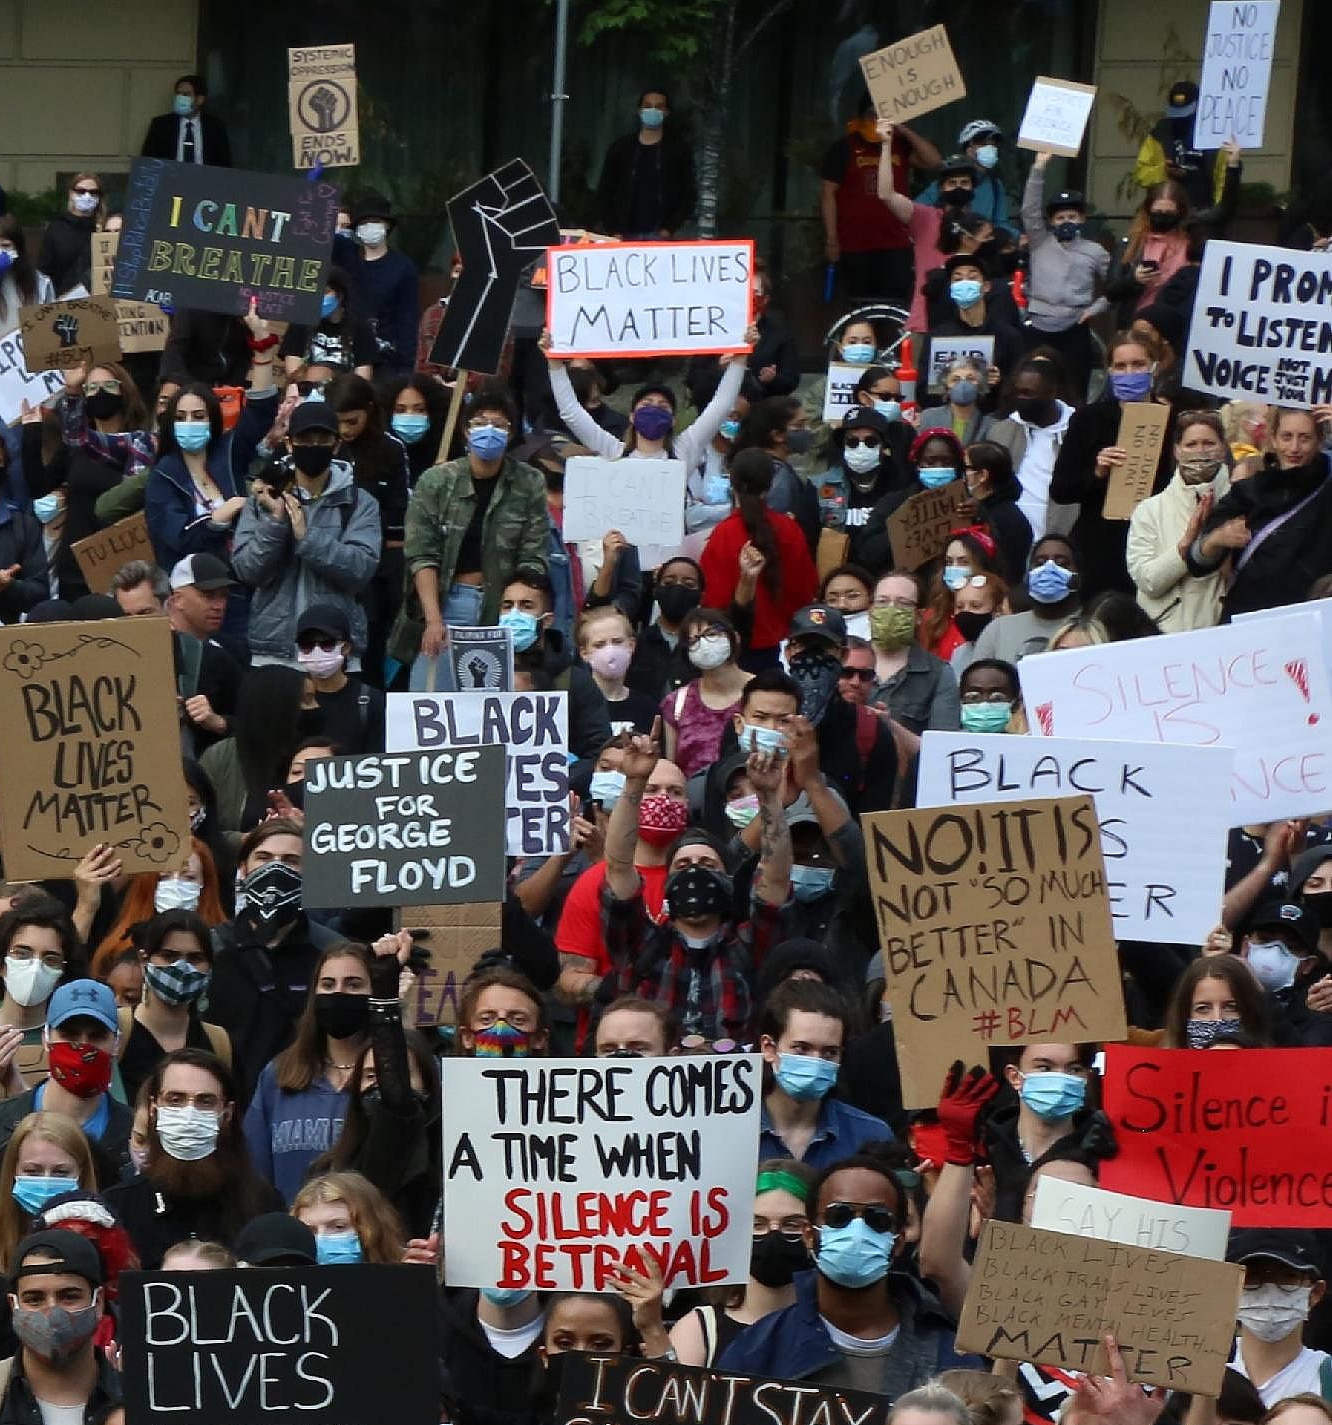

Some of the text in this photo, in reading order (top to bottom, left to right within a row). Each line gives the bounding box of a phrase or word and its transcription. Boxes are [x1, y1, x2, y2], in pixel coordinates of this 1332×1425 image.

[1233, 4, 1258, 29] NO
[293, 50, 354, 63] SYSTEMIC
[864, 34, 947, 79] ENOUGH
[1209, 33, 1269, 60] JUSTICE
[879, 75, 956, 117] ENOUGH
[898, 68, 918, 87] IS
[1221, 65, 1249, 91] NO
[1201, 95, 1263, 135] PEACE
[302, 133, 346, 149] ENDS
[168, 196, 184, 228] I
[191, 198, 292, 243] CANT
[147, 239, 322, 292] BREATHE
[556, 251, 750, 293] BLACK LIVES
[1219, 255, 1232, 296] I
[570, 304, 728, 347] MATTER
[1211, 306, 1240, 328] TO
[1192, 349, 1271, 394] VOICE
[22, 674, 142, 743] BLACK
[1072, 647, 1277, 726] SILENCE
[412, 695, 562, 748] BLACK
[54, 742, 136, 791] LIVES
[946, 747, 1153, 801] BLACK
[23, 783, 163, 839] MATTER
[376, 792, 436, 821] FOR
[310, 817, 452, 855] GEORGE
[1054, 803, 1095, 861] IS
[350, 854, 478, 896] FLOYD
[877, 868, 1104, 933] NOT MUCH
[1049, 916, 1085, 949] IN
[908, 959, 1100, 1022] CANADA
[971, 1005, 1087, 1040] #BLM
[480, 1060, 754, 1126] THERE COMES
[1121, 1063, 1292, 1133] Silence
[447, 1130, 702, 1184] A TIME WHEN
[500, 1186, 731, 1242] SILENCE IS
[988, 1224, 1187, 1276] BLACK LIVES
[977, 1282, 1044, 1306] BLACK
[1122, 1299, 1194, 1324] LIVES
[982, 1256, 1202, 1305] BLACK TRANS LIVES
[143, 1282, 339, 1348] BLACK
[975, 1302, 1048, 1328] BLACK
[148, 1350, 334, 1412] LIVES
[585, 1356, 611, 1412] I
